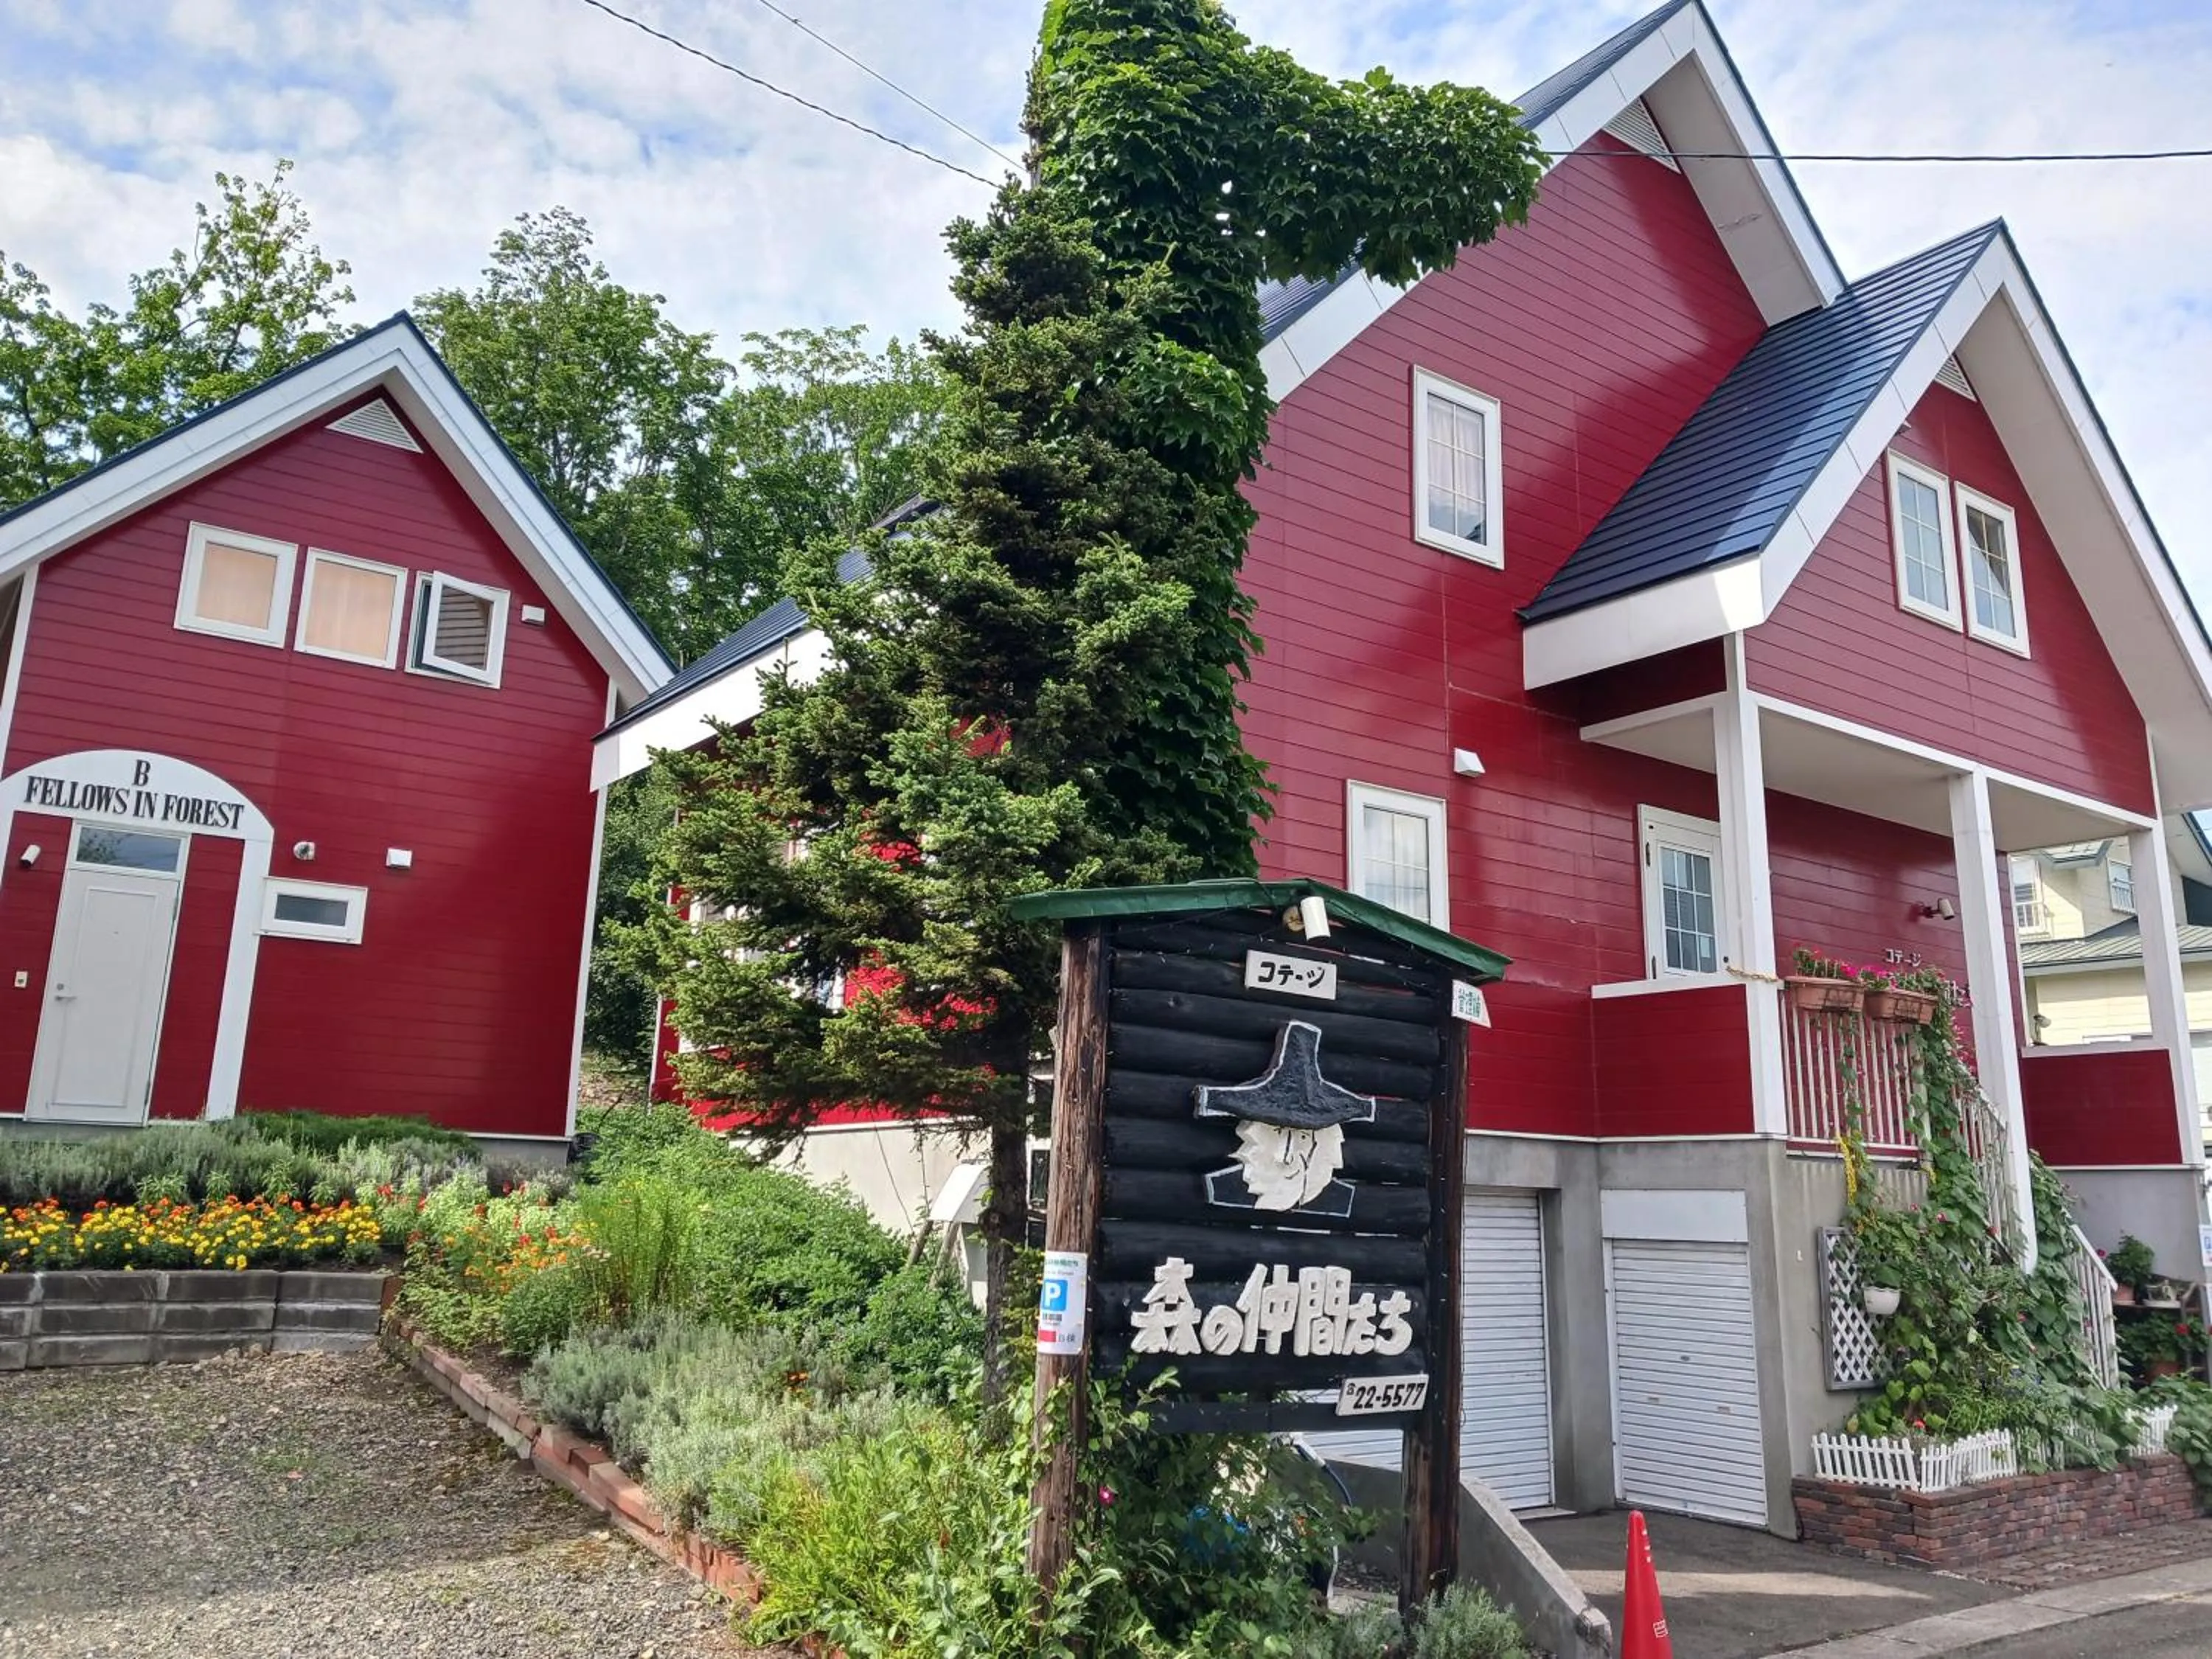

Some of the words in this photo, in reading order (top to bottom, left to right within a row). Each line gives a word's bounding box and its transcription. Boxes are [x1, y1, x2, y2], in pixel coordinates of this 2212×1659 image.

[132, 759, 152, 786] B
[24, 776, 130, 815] FELLOWS
[133, 790, 158, 818] IN
[161, 794, 245, 830] FOREST
[1258, 961, 1325, 988] コテージ
[1043, 1281, 1062, 1308] P
[1130, 1257, 1413, 1356] 森の仲間たち
